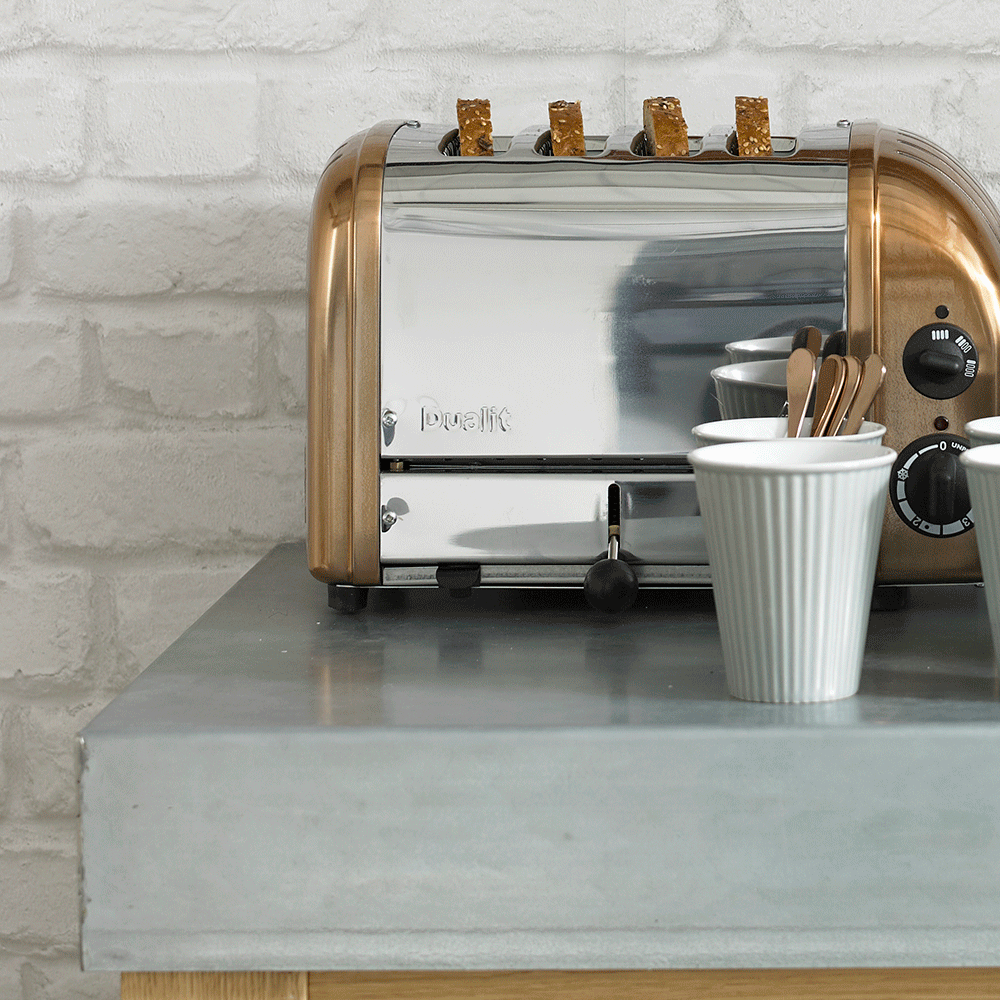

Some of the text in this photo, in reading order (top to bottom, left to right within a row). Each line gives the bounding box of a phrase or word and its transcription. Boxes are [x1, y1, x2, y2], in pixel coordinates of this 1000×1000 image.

[420, 404, 512, 432] Dualit
[939, 440, 947, 451] 0
[912, 516, 922, 527] 2
[961, 517, 971, 527] 3
